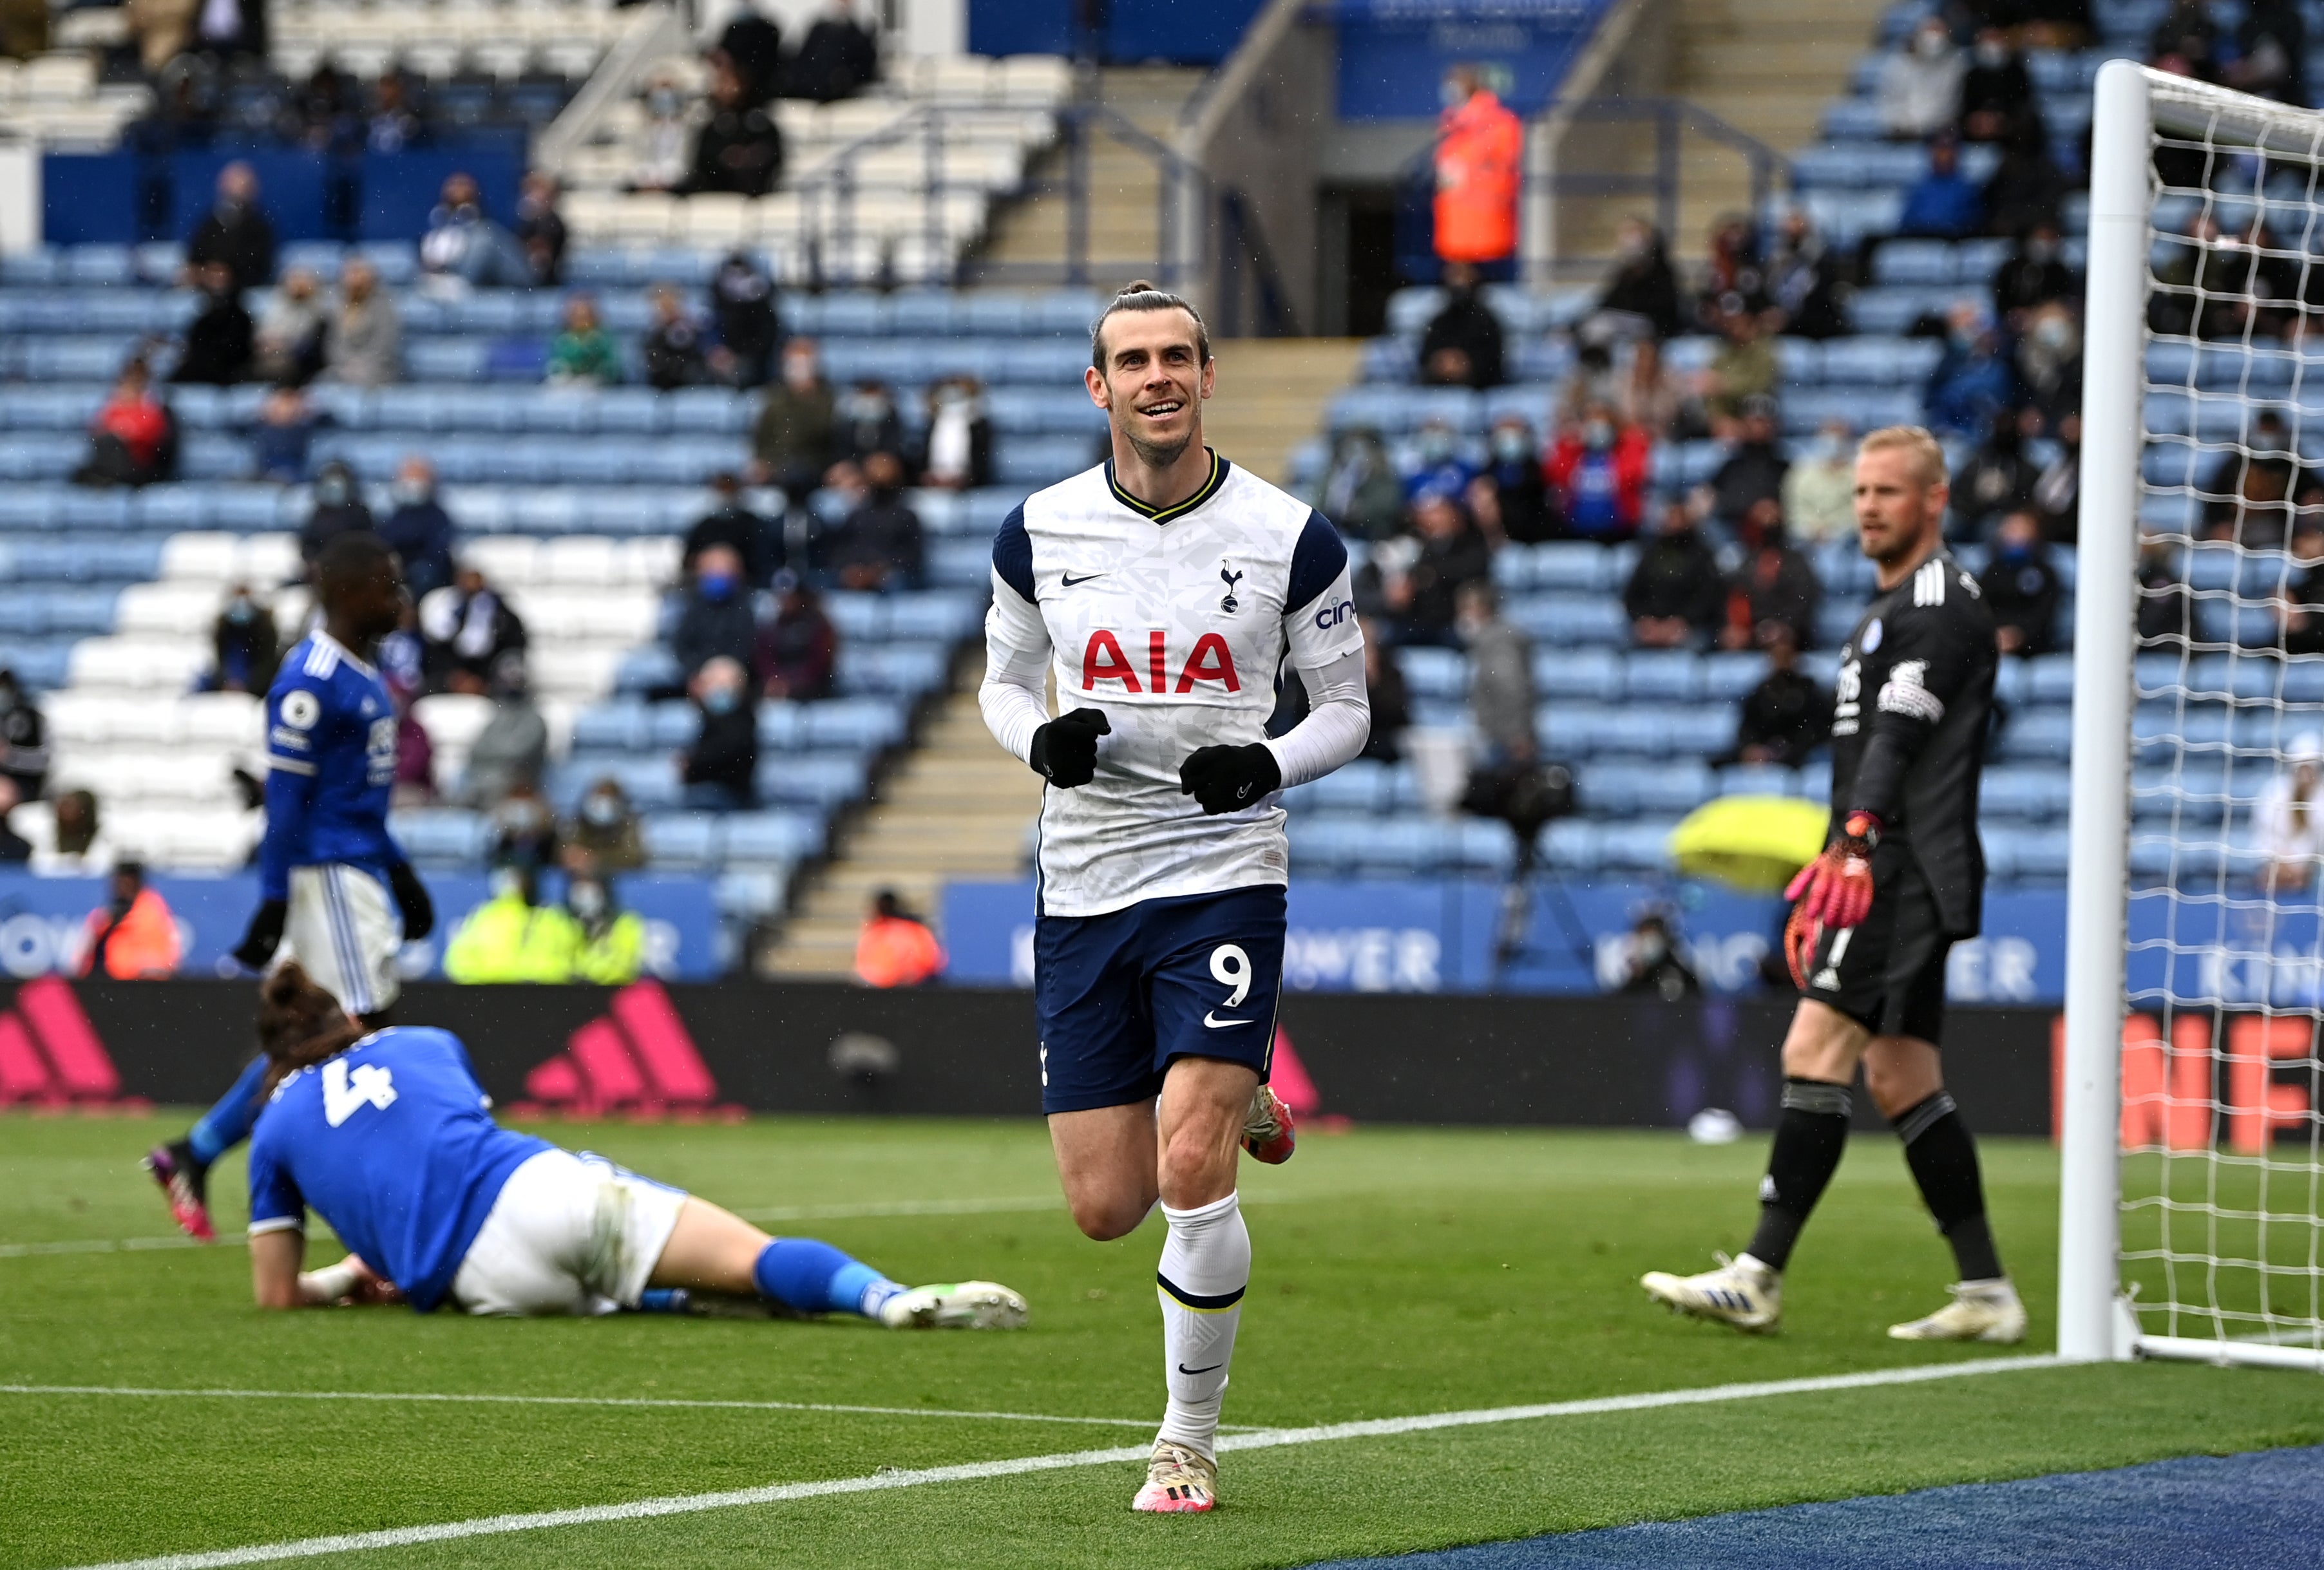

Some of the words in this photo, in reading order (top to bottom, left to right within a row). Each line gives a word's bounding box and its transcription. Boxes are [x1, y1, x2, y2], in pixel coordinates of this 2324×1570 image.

[1315, 596, 1355, 630] cin
[1081, 629, 1242, 694] AIA
[1209, 943, 1252, 1008] 9
[321, 1057, 399, 1129] 4
